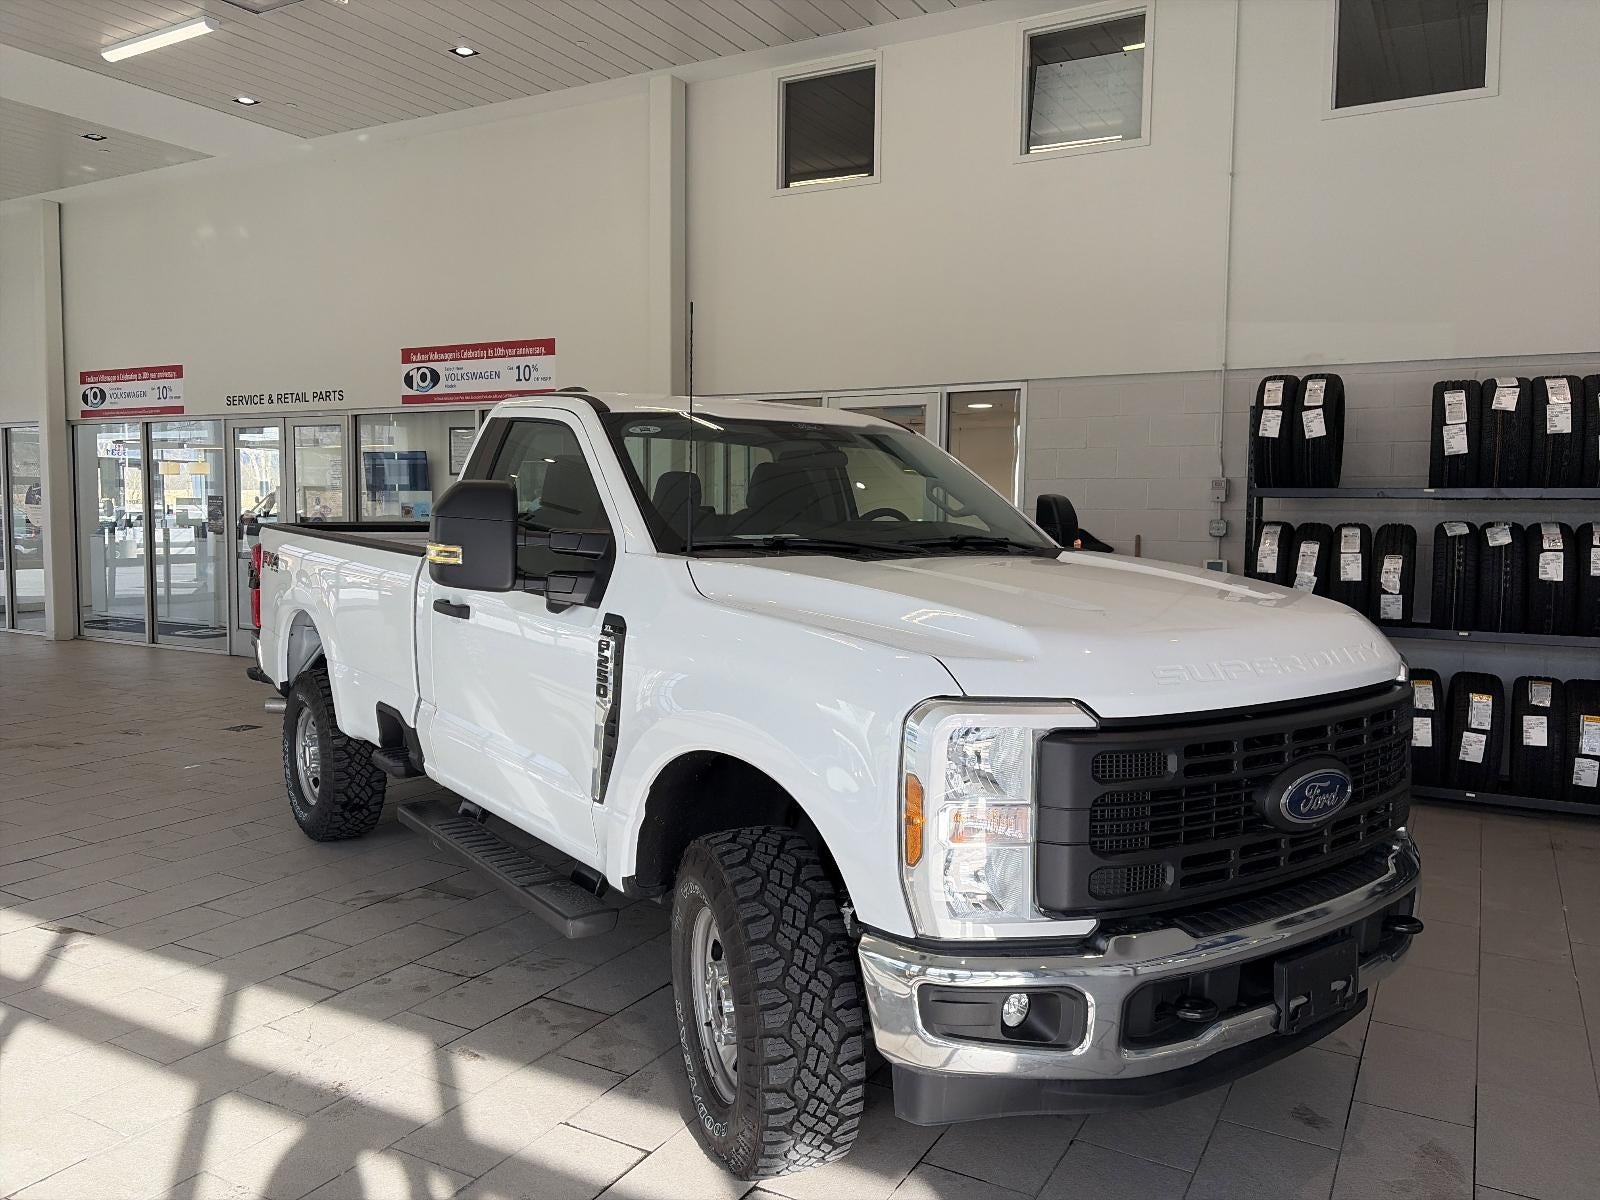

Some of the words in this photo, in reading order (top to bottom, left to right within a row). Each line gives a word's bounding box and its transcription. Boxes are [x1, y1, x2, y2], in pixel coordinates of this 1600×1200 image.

[429, 351, 456, 361] Volkswagen
[461, 348, 487, 359] Celebrating
[494, 346, 506, 356] 10th
[506, 348, 516, 357] year
[444, 370, 501, 382] VOLKSWAGEN
[108, 390, 147, 401] VOLKSWAGEN
[225, 395, 265, 407] SERVICE
[267, 393, 274, 405] &
[276, 391, 310, 404] RETAIL
[312, 389, 345, 403] PARTS
[1300, 780, 1340, 814] Ford
